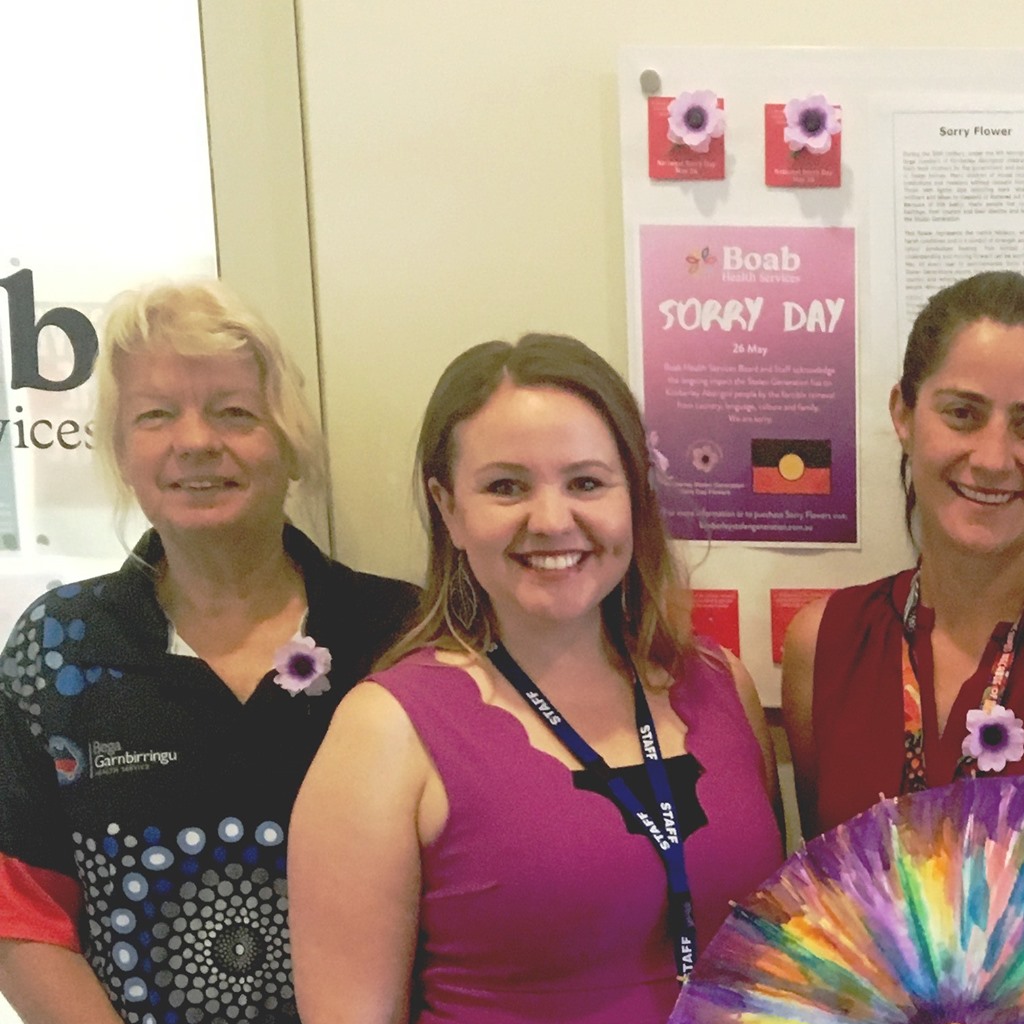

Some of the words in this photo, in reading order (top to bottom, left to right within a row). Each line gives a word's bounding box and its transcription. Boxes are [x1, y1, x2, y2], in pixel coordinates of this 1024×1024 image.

[939, 126, 969, 138] Sorry
[974, 126, 1013, 136] Flower
[722, 245, 801, 271] Boab
[722, 272, 756, 283] Health
[759, 273, 800, 284] Services
[658, 297, 764, 332] SORRY
[782, 297, 845, 333] DAY
[733, 343, 745, 353] 26
[747, 343, 768, 356] May
[526, 691, 562, 726] STAFF
[640, 724, 658, 761] STAFF
[94, 749, 178, 769] Garnbirringu
[637, 811, 671, 851] STAFF
[660, 802, 678, 844] STAFF
